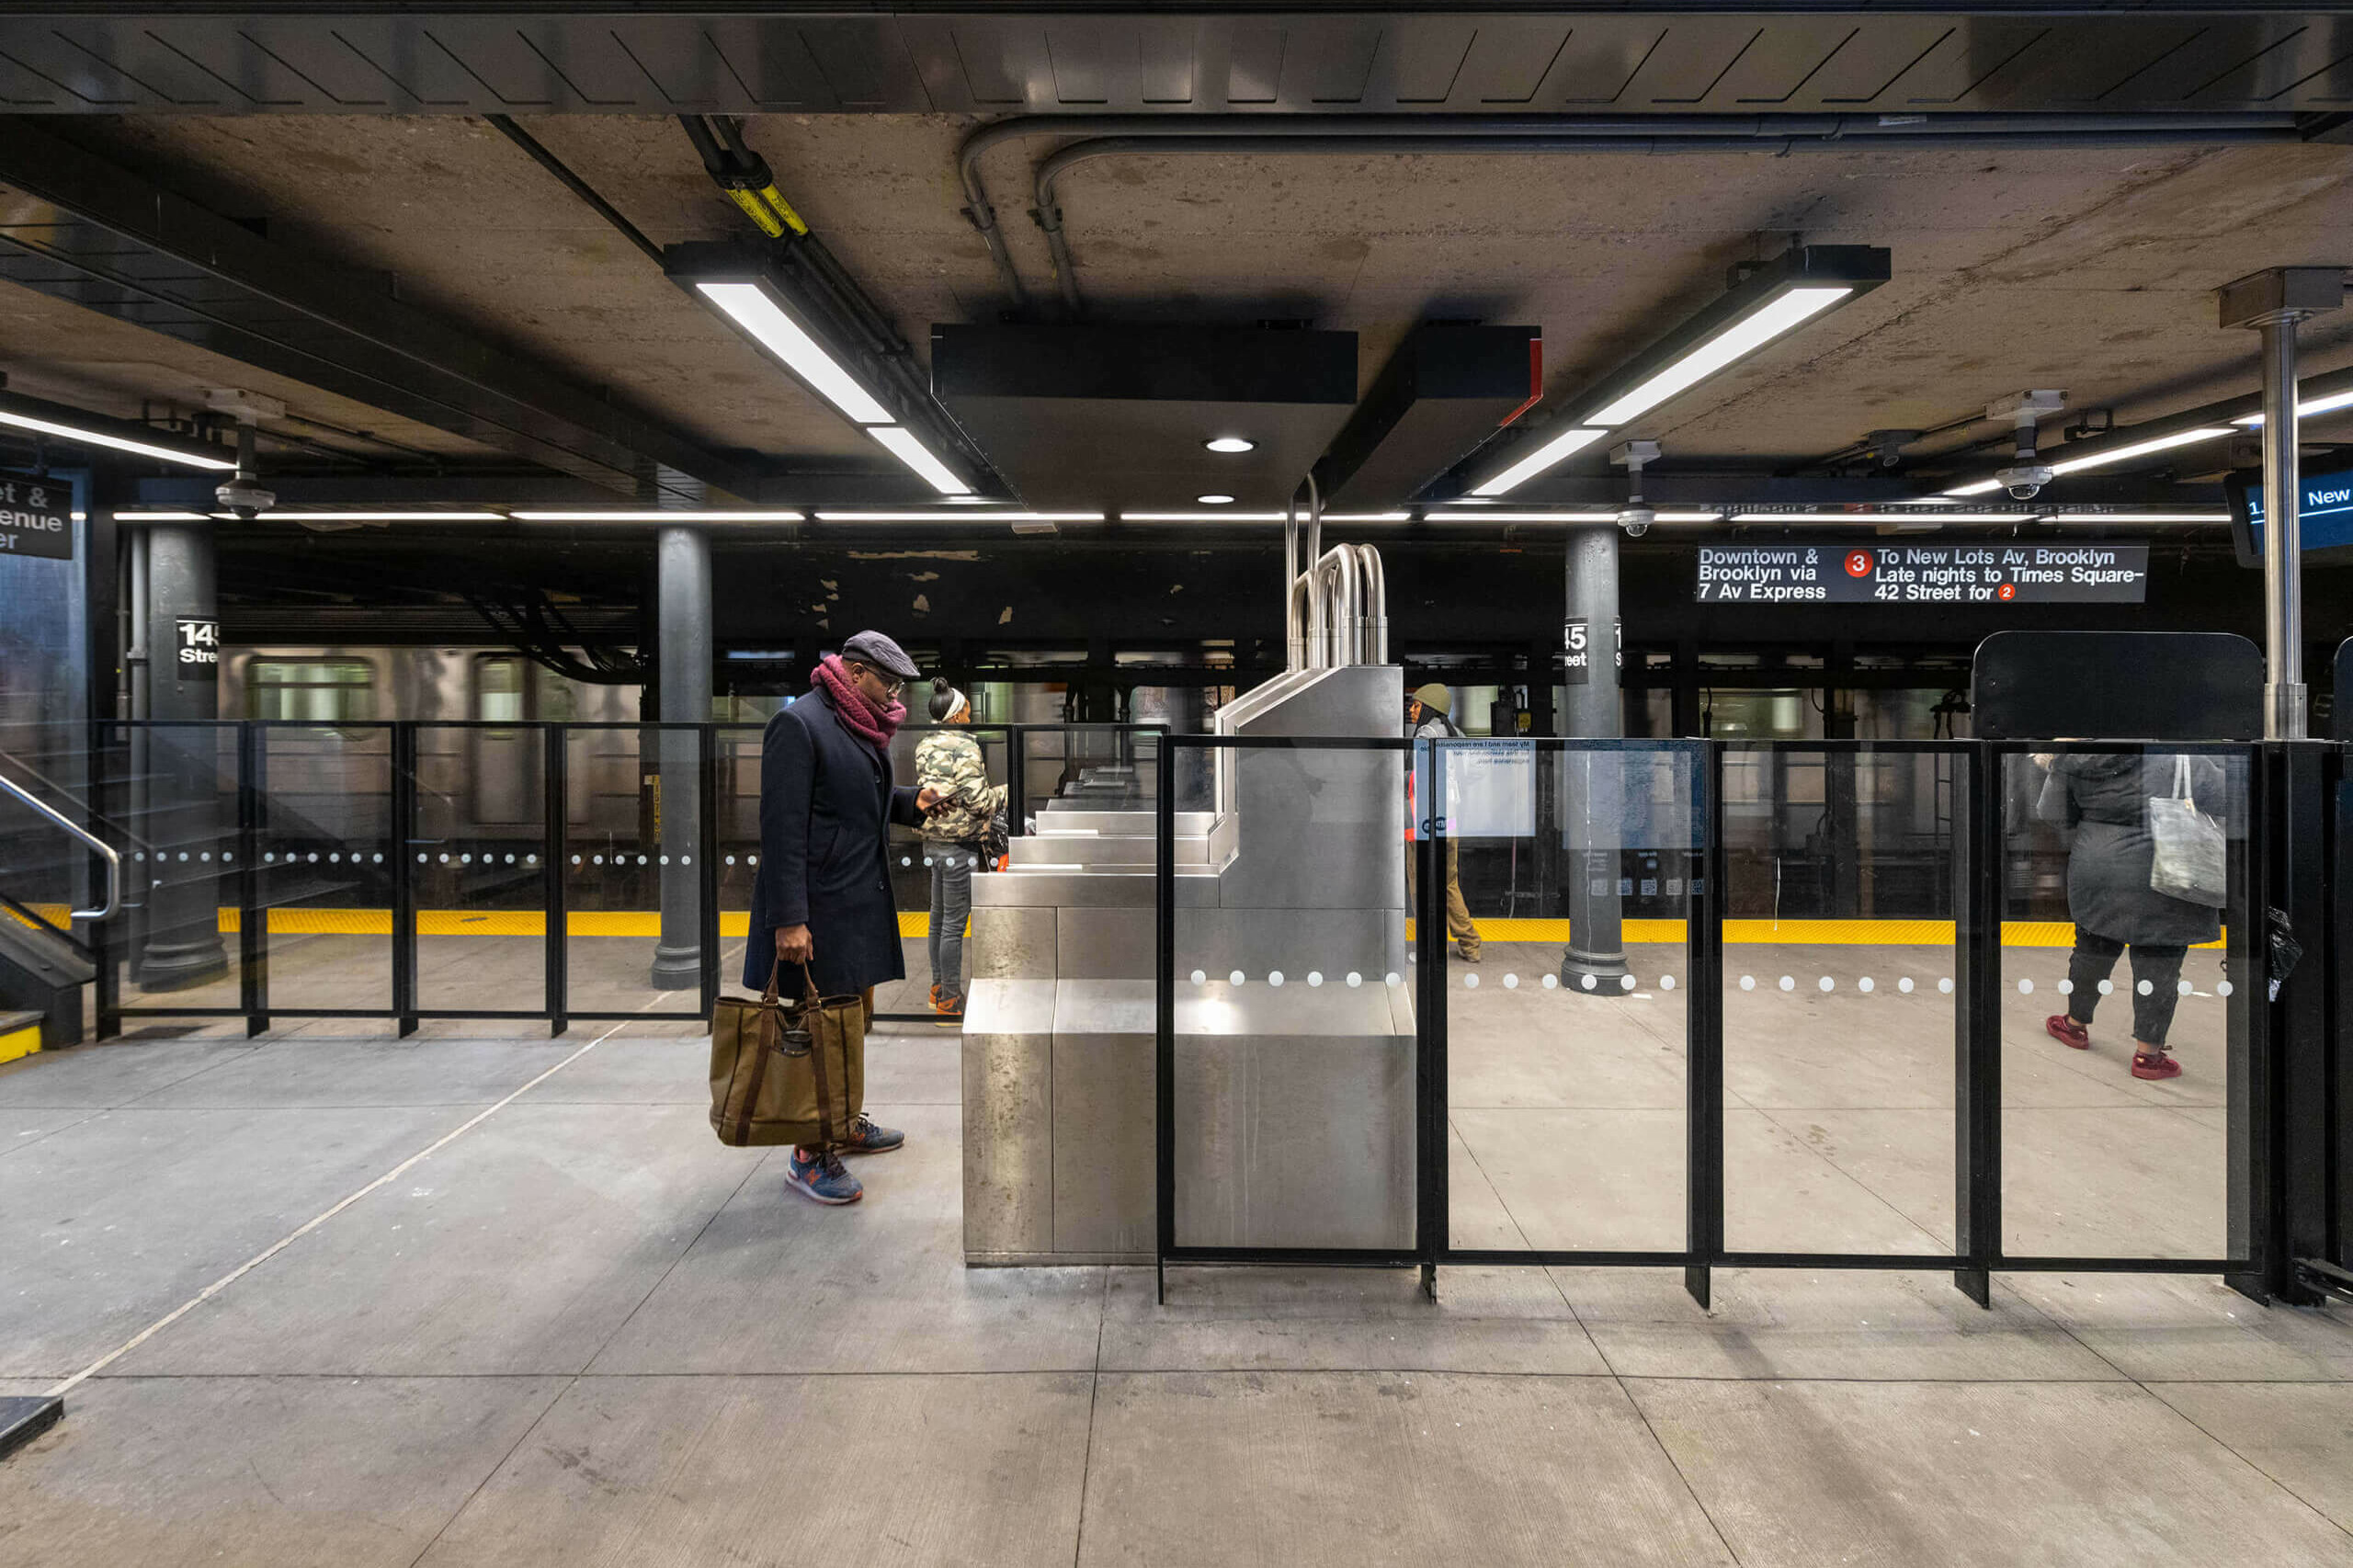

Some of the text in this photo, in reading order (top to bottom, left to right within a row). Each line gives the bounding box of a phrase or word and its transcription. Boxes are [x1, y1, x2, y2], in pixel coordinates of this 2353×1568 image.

[29, 487, 48, 508] &
[2308, 489, 2350, 506] New
[0, 510, 63, 532] enue
[1700, 549, 1818, 564] Downtown &
[1852, 554, 1866, 572] 3
[1877, 549, 2115, 568] To New Lots Av, Brooklyn
[1699, 565, 1816, 584] Brooklyn via
[1875, 567, 1915, 582] Late
[1922, 567, 1976, 585] nights
[1984, 568, 2002, 582] to
[2010, 567, 2063, 583] Times
[1699, 583, 1826, 603] 7 Av Express
[1875, 585, 1899, 600] 42
[1906, 585, 1962, 600] Street
[1969, 585, 1994, 600] for
